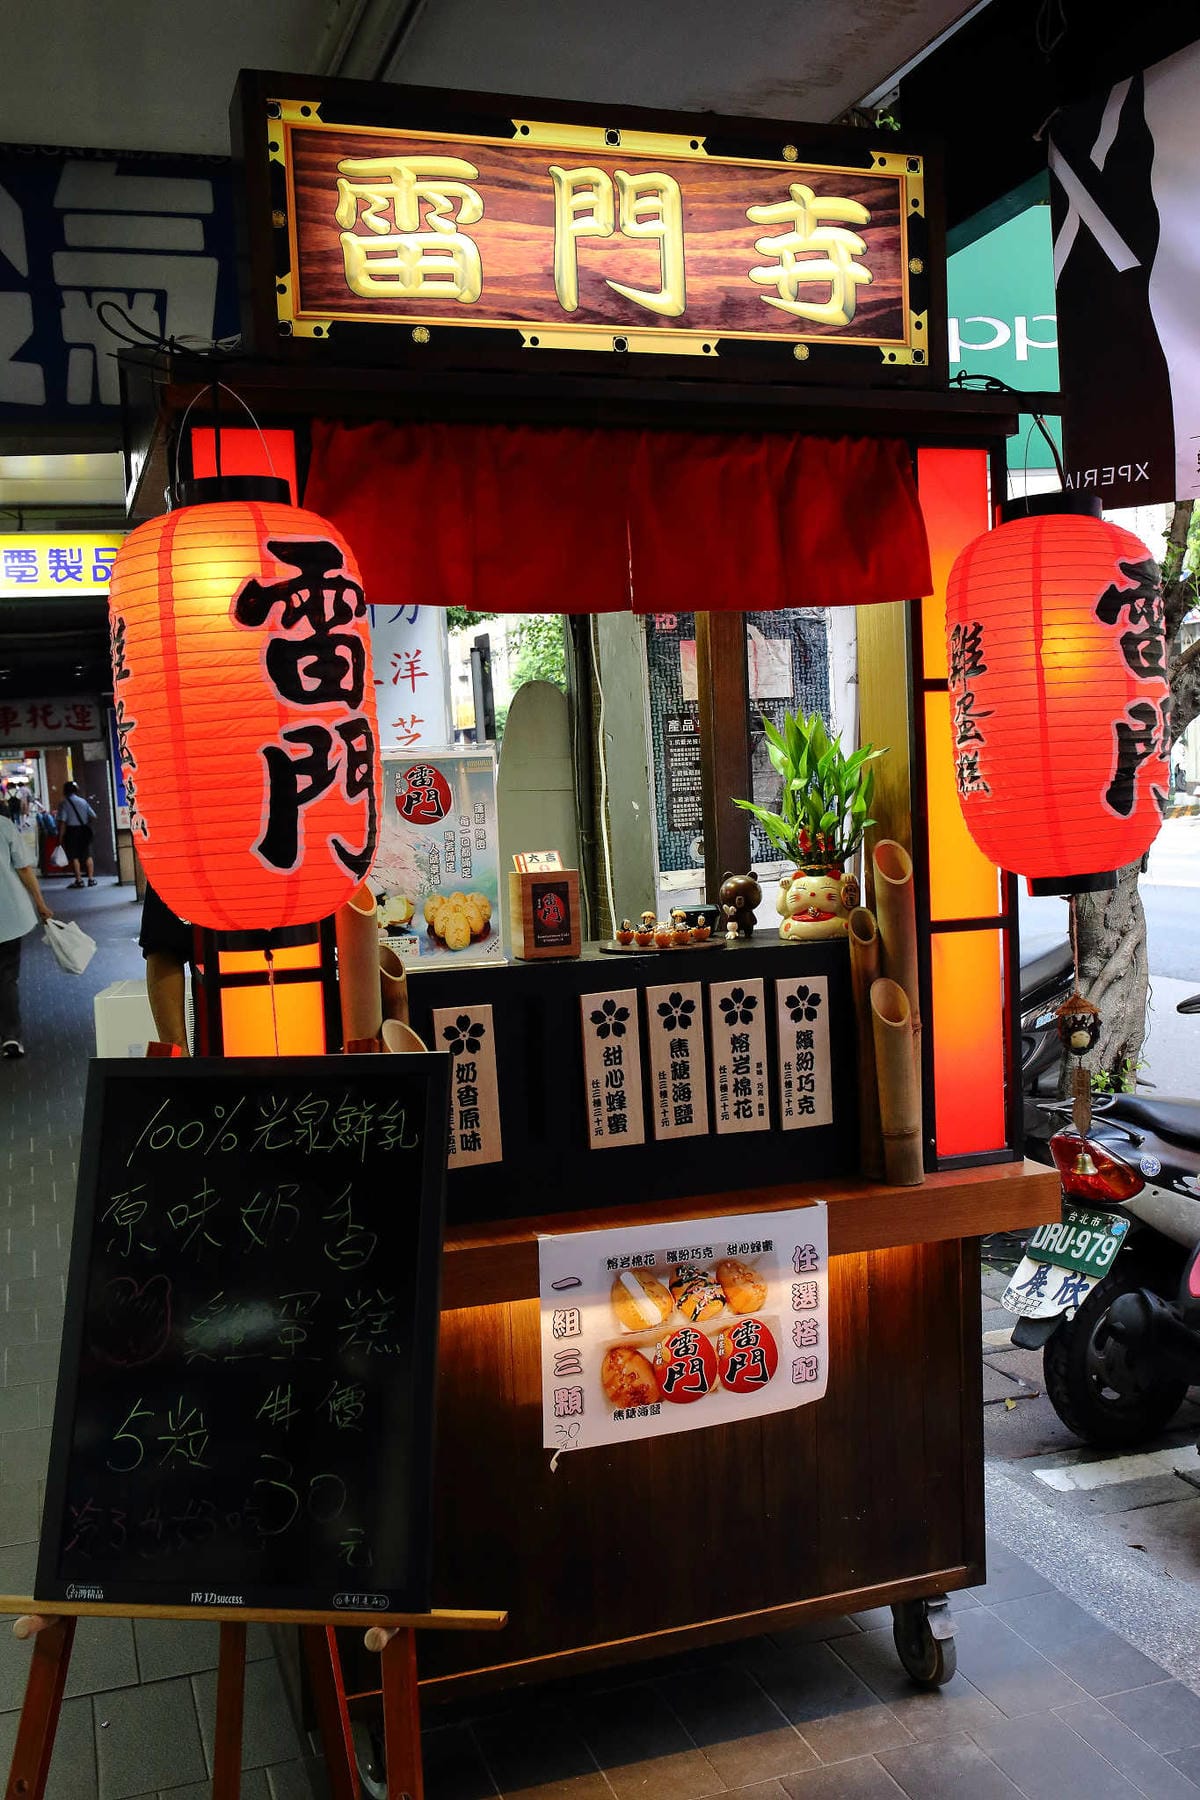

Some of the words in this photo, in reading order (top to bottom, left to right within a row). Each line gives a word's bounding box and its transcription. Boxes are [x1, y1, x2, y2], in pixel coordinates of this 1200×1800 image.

[235, 541, 376, 880] 雷門
[950, 621, 995, 796] 雞蛋糕
[402, 765, 445, 818] 雷門
[455, 1061, 482, 1152] 奶香原味
[602, 1045, 628, 1135] 甜心蜂蜜
[669, 1037, 694, 1126] 焦糖海鹽
[730, 1033, 753, 1120] 熔岩棉花
[796, 1029, 816, 1116] 繽紛巧克
[666, 1246, 714, 1264] 繽紛巧克
[726, 1239, 773, 1256] 甜心蜂蜜
[1068, 1211, 1101, 1227] 台北市
[551, 1276, 583, 1417] 一組三顆
[726, 1320, 770, 1383] 雷門
[792, 1244, 818, 1384] 任選搭配
[663, 1329, 709, 1393] 雷門
[613, 1403, 661, 1421] 焦糖海鹽
